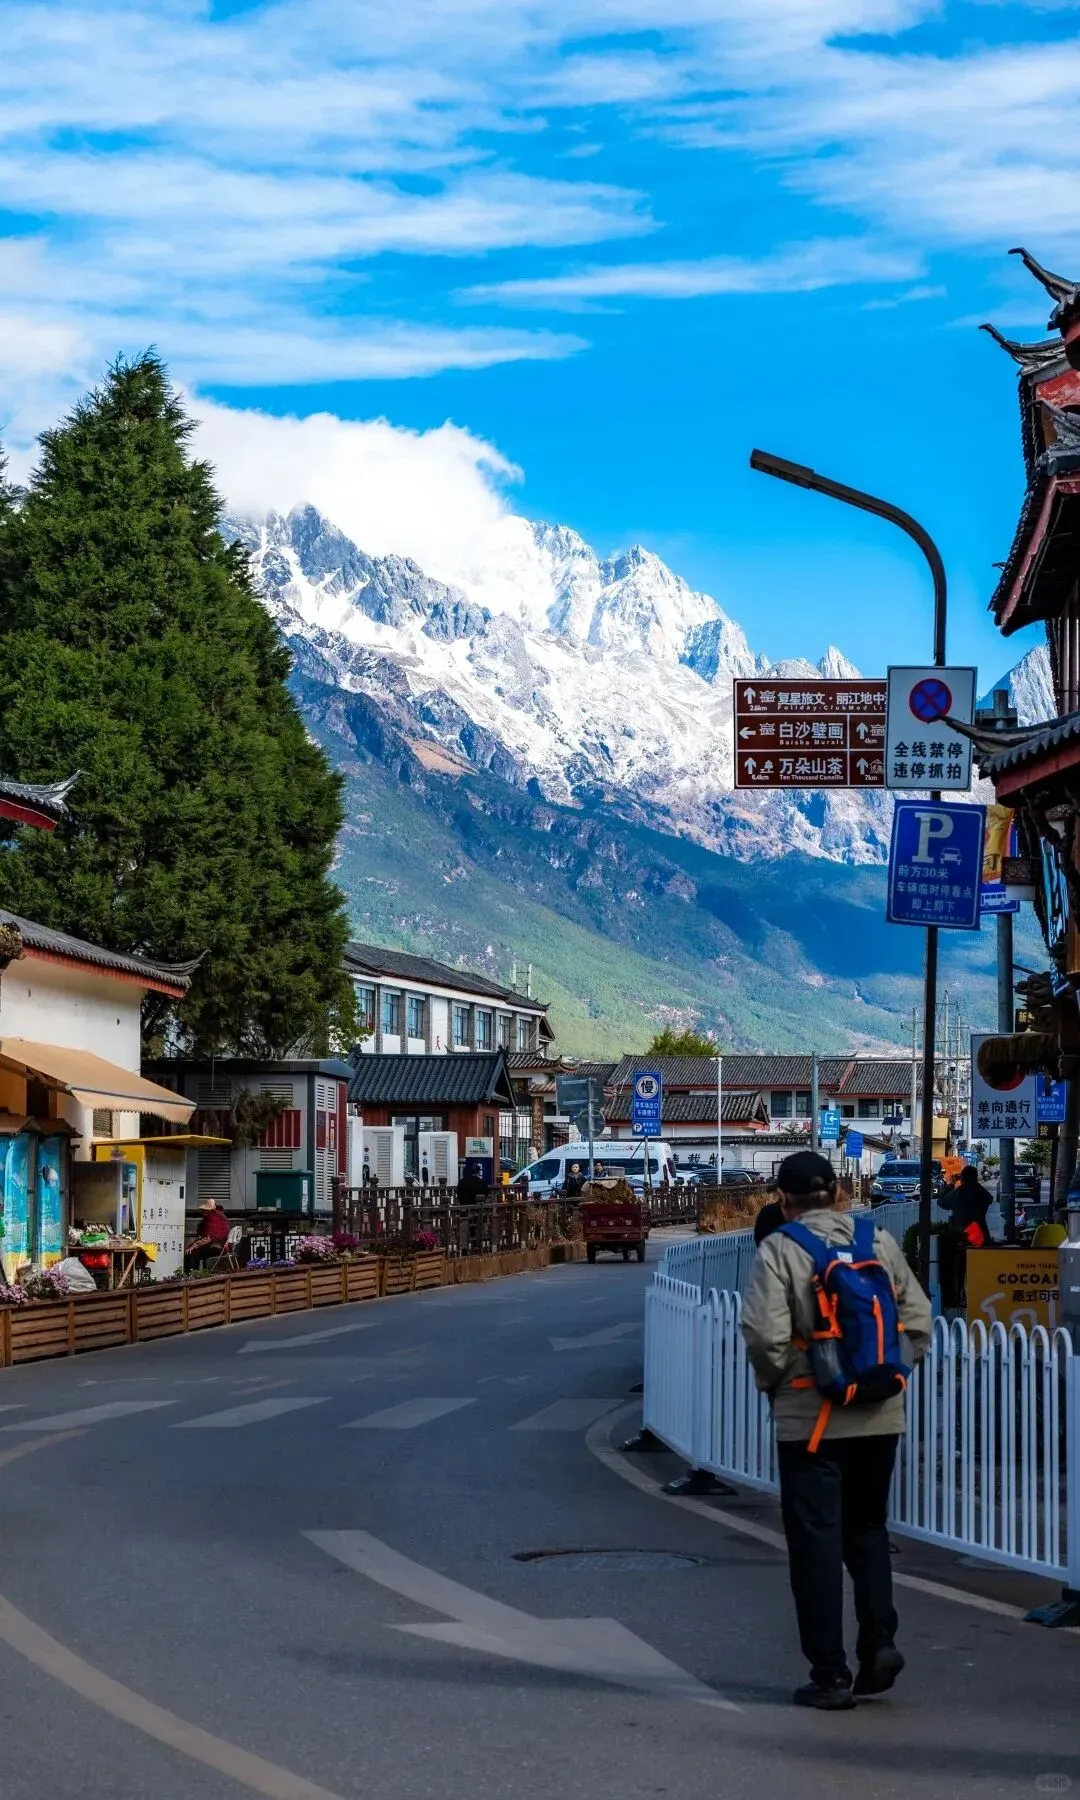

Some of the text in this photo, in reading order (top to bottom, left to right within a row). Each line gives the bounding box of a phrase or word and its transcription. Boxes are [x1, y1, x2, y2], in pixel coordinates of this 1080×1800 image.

[779, 721, 844, 740] 白沙壁画
[894, 740, 964, 759] 全线禁停
[778, 757, 843, 775] 万朵山茶
[893, 761, 962, 780] 违停抓拍
[911, 811, 955, 864] P
[897, 864, 950, 880] 前方30米
[640, 1080, 654, 1094] 慢
[977, 1100, 1031, 1115] 单向通行
[977, 1116, 1032, 1131] 禁止驶入
